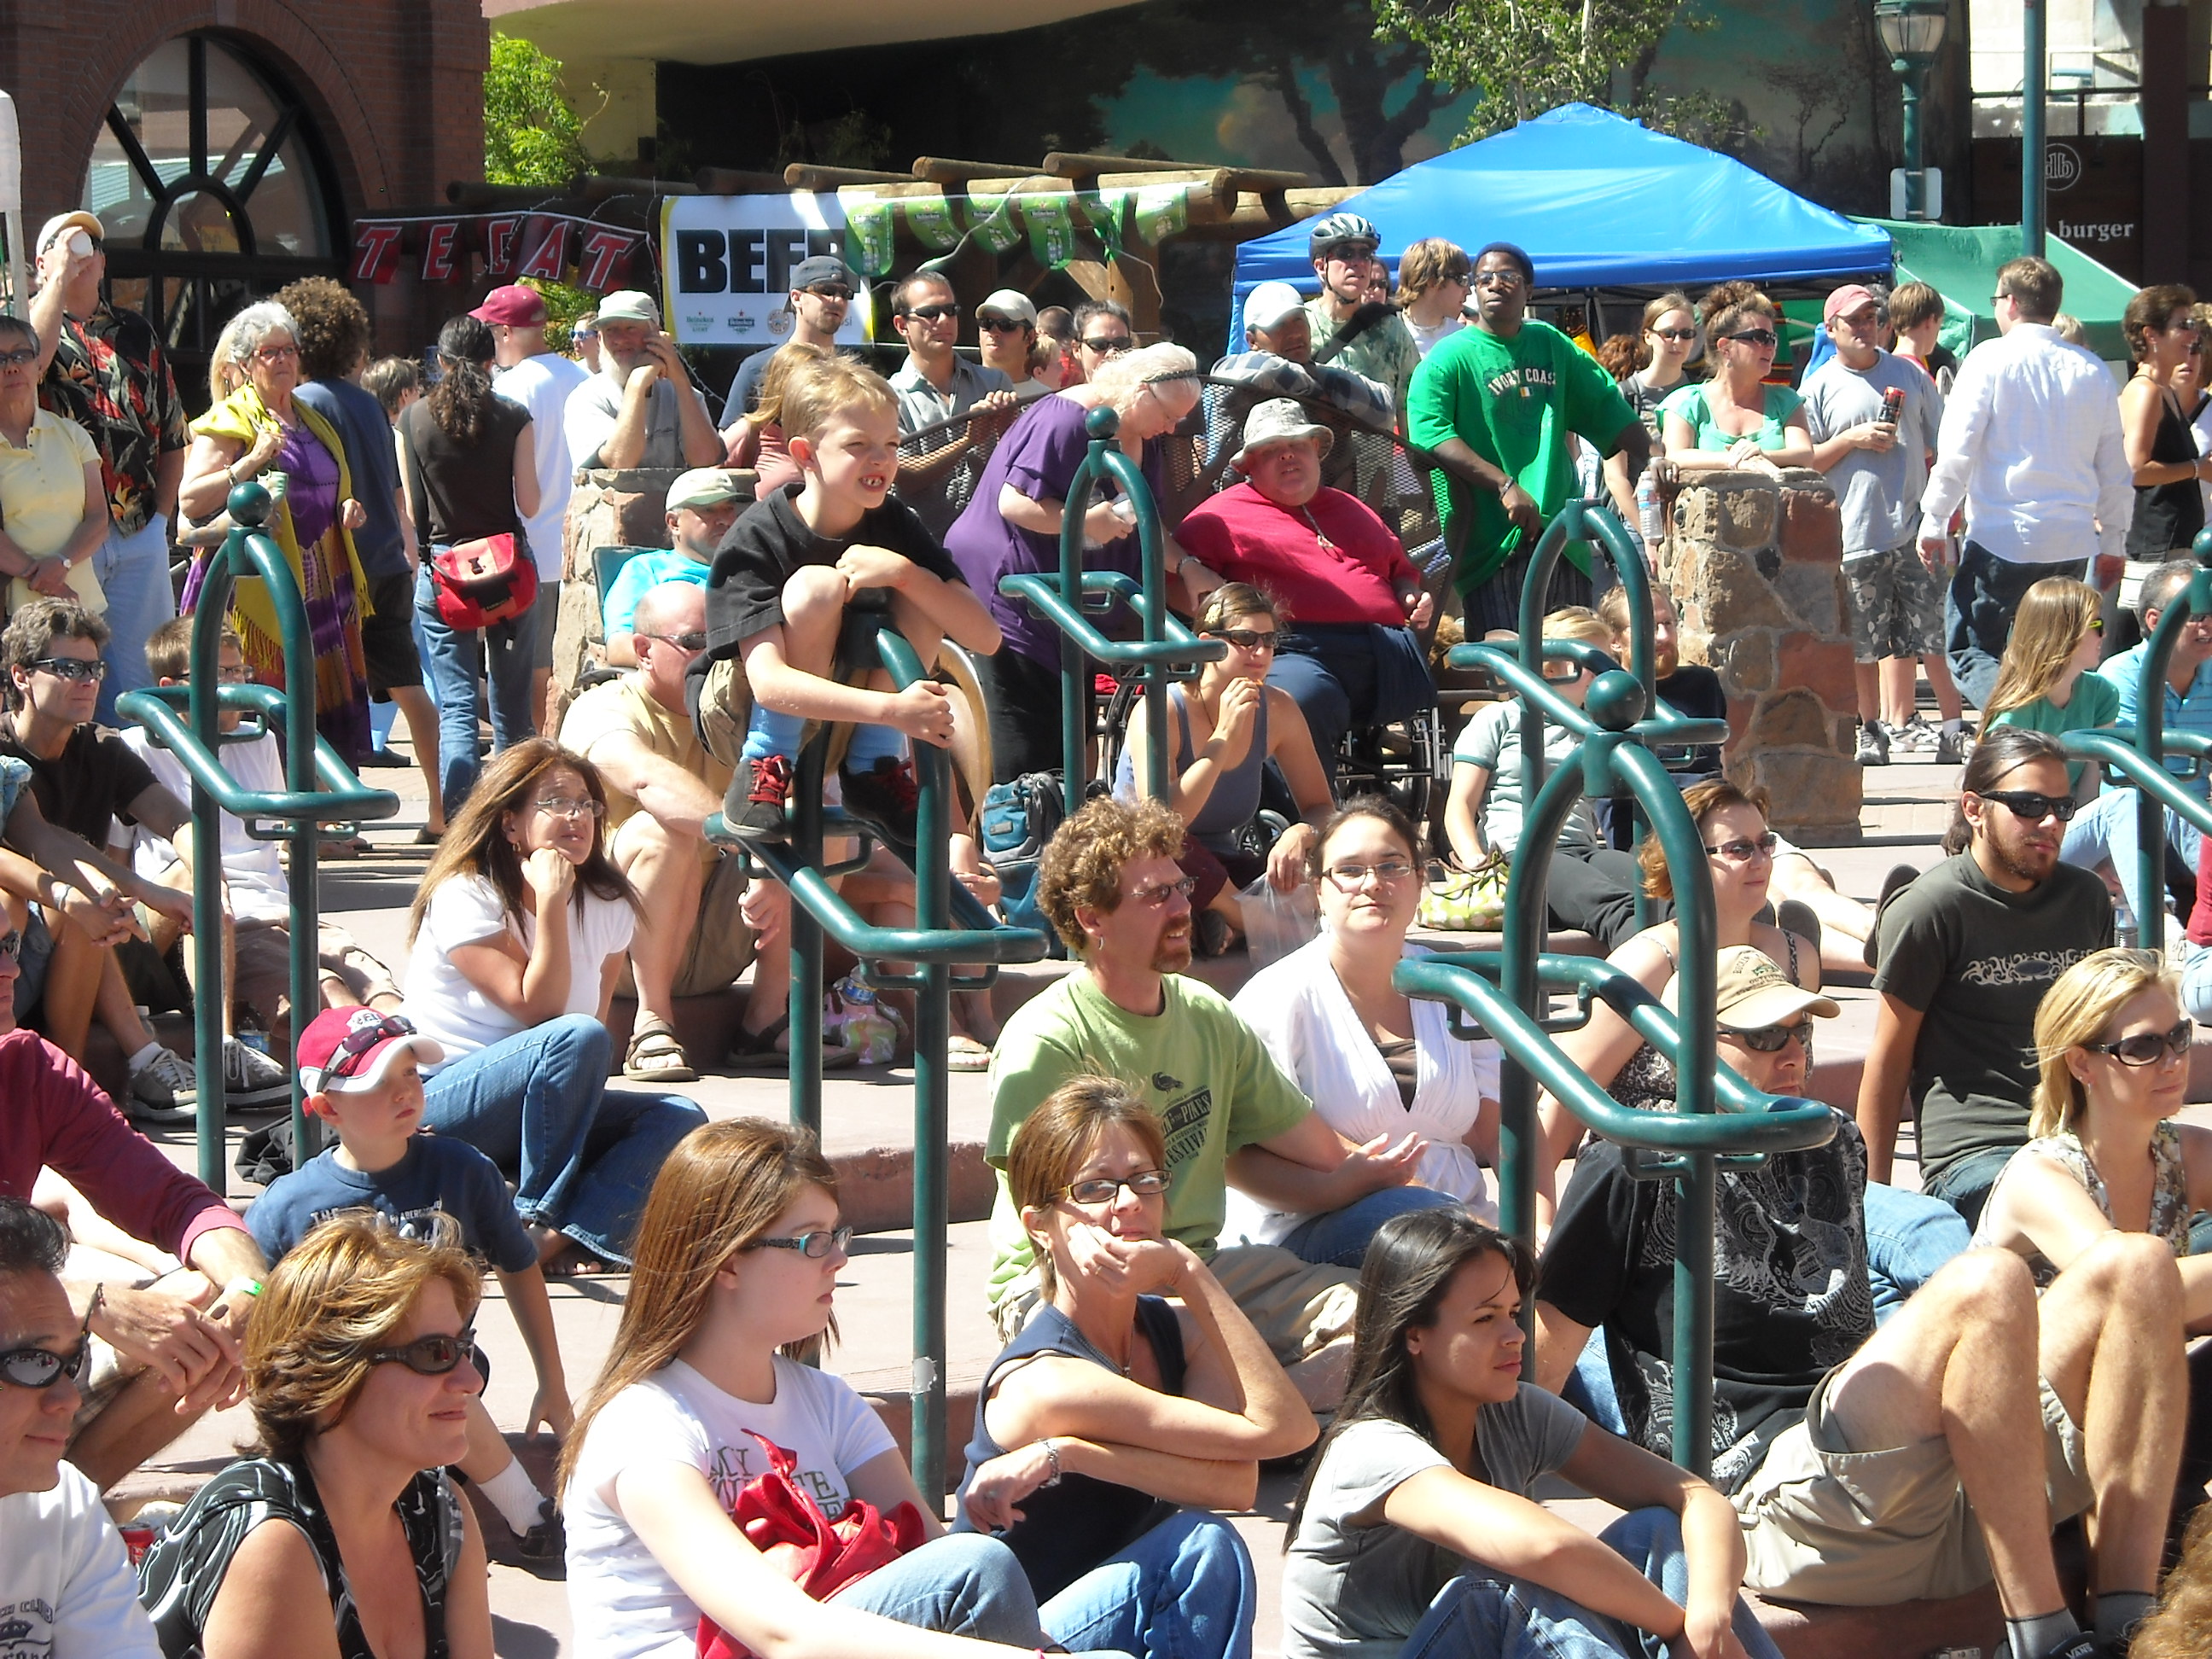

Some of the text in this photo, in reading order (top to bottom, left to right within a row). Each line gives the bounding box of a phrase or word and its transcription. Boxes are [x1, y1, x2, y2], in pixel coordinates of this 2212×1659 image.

[2058, 219, 2133, 242] burger
[676, 229, 861, 294] BEER
[1487, 369, 1522, 396] IVORY
[1180, 1095, 1211, 1122] PINES
[20, 1598, 53, 1624] CLUB
[2065, 1642, 2093, 1659] VANS
